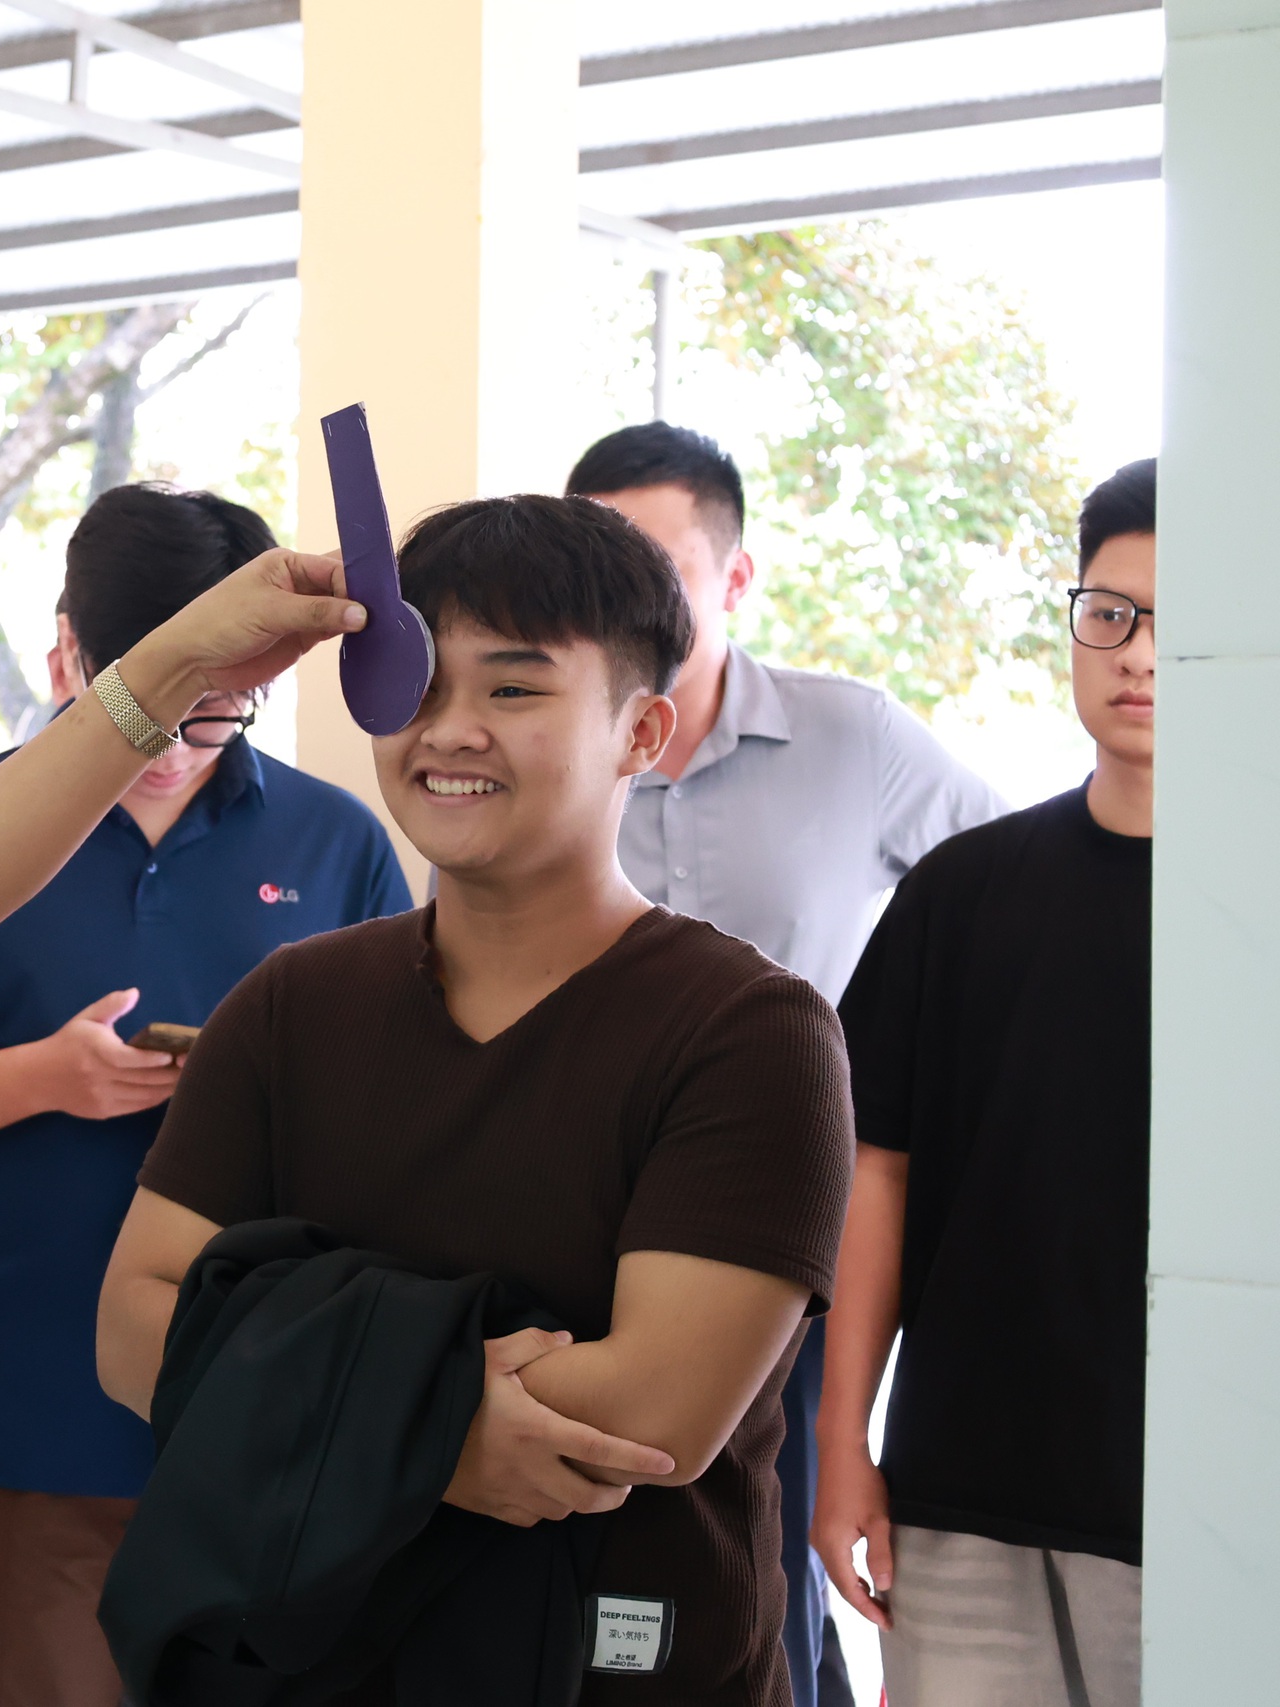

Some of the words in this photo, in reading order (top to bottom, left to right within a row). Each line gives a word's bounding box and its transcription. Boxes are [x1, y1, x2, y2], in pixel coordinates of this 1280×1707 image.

[600, 1611, 621, 1619] DEEP
[622, 1613, 661, 1623] FEELINGS
[608, 1629, 650, 1642] 深い気持ち
